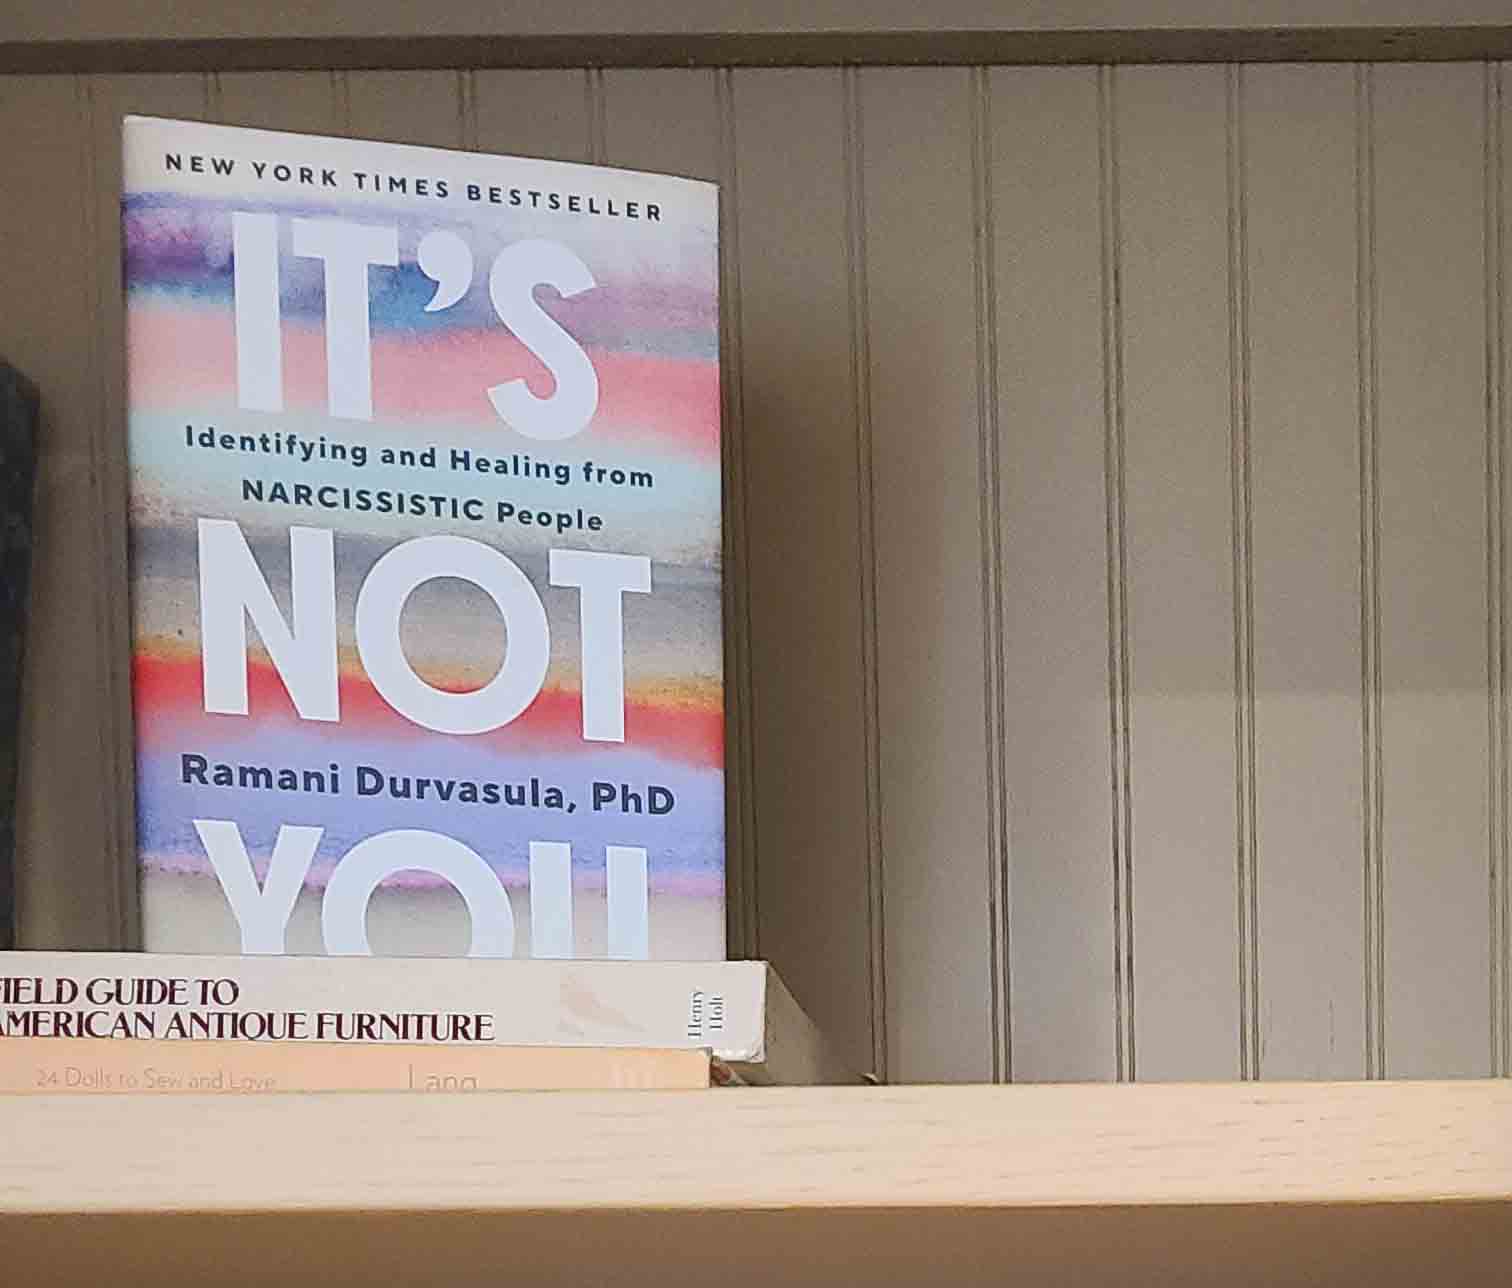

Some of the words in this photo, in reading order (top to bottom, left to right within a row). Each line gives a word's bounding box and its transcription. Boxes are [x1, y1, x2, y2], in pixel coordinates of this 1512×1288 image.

[165, 153, 236, 175] NEW
[253, 161, 338, 187] YORK
[354, 173, 450, 198] TIMES
[468, 183, 662, 222] BESTSELLER
[231, 210, 600, 441] IT’S
[185, 425, 368, 467] Identifying
[380, 445, 436, 470] and
[450, 449, 571, 486] Healing
[582, 459, 654, 488] from
[242, 478, 485, 521] NARCISSISTIC
[497, 502, 603, 533] People
[197, 516, 652, 742] NOT
[181, 752, 341, 796] Ramani
[357, 766, 577, 815] Durvasula,
[592, 782, 676, 816] PhD
[0, 977, 78, 1005] IELD
[86, 977, 189, 1006] GUIDE
[193, 979, 240, 1006] TO
[688, 986, 704, 1036] Henry
[709, 997, 723, 1029] Holt
[165, 1012, 309, 1042] ANTIQUE
[316, 1013, 495, 1042] FURNITURE
[36, 1067, 58, 1086] 24
[65, 1066, 115, 1088] Dolls
[119, 1071, 138, 1088] to
[143, 1067, 182, 1088] Sew
[188, 1069, 223, 1089] and
[231, 1072, 277, 1091] Love
